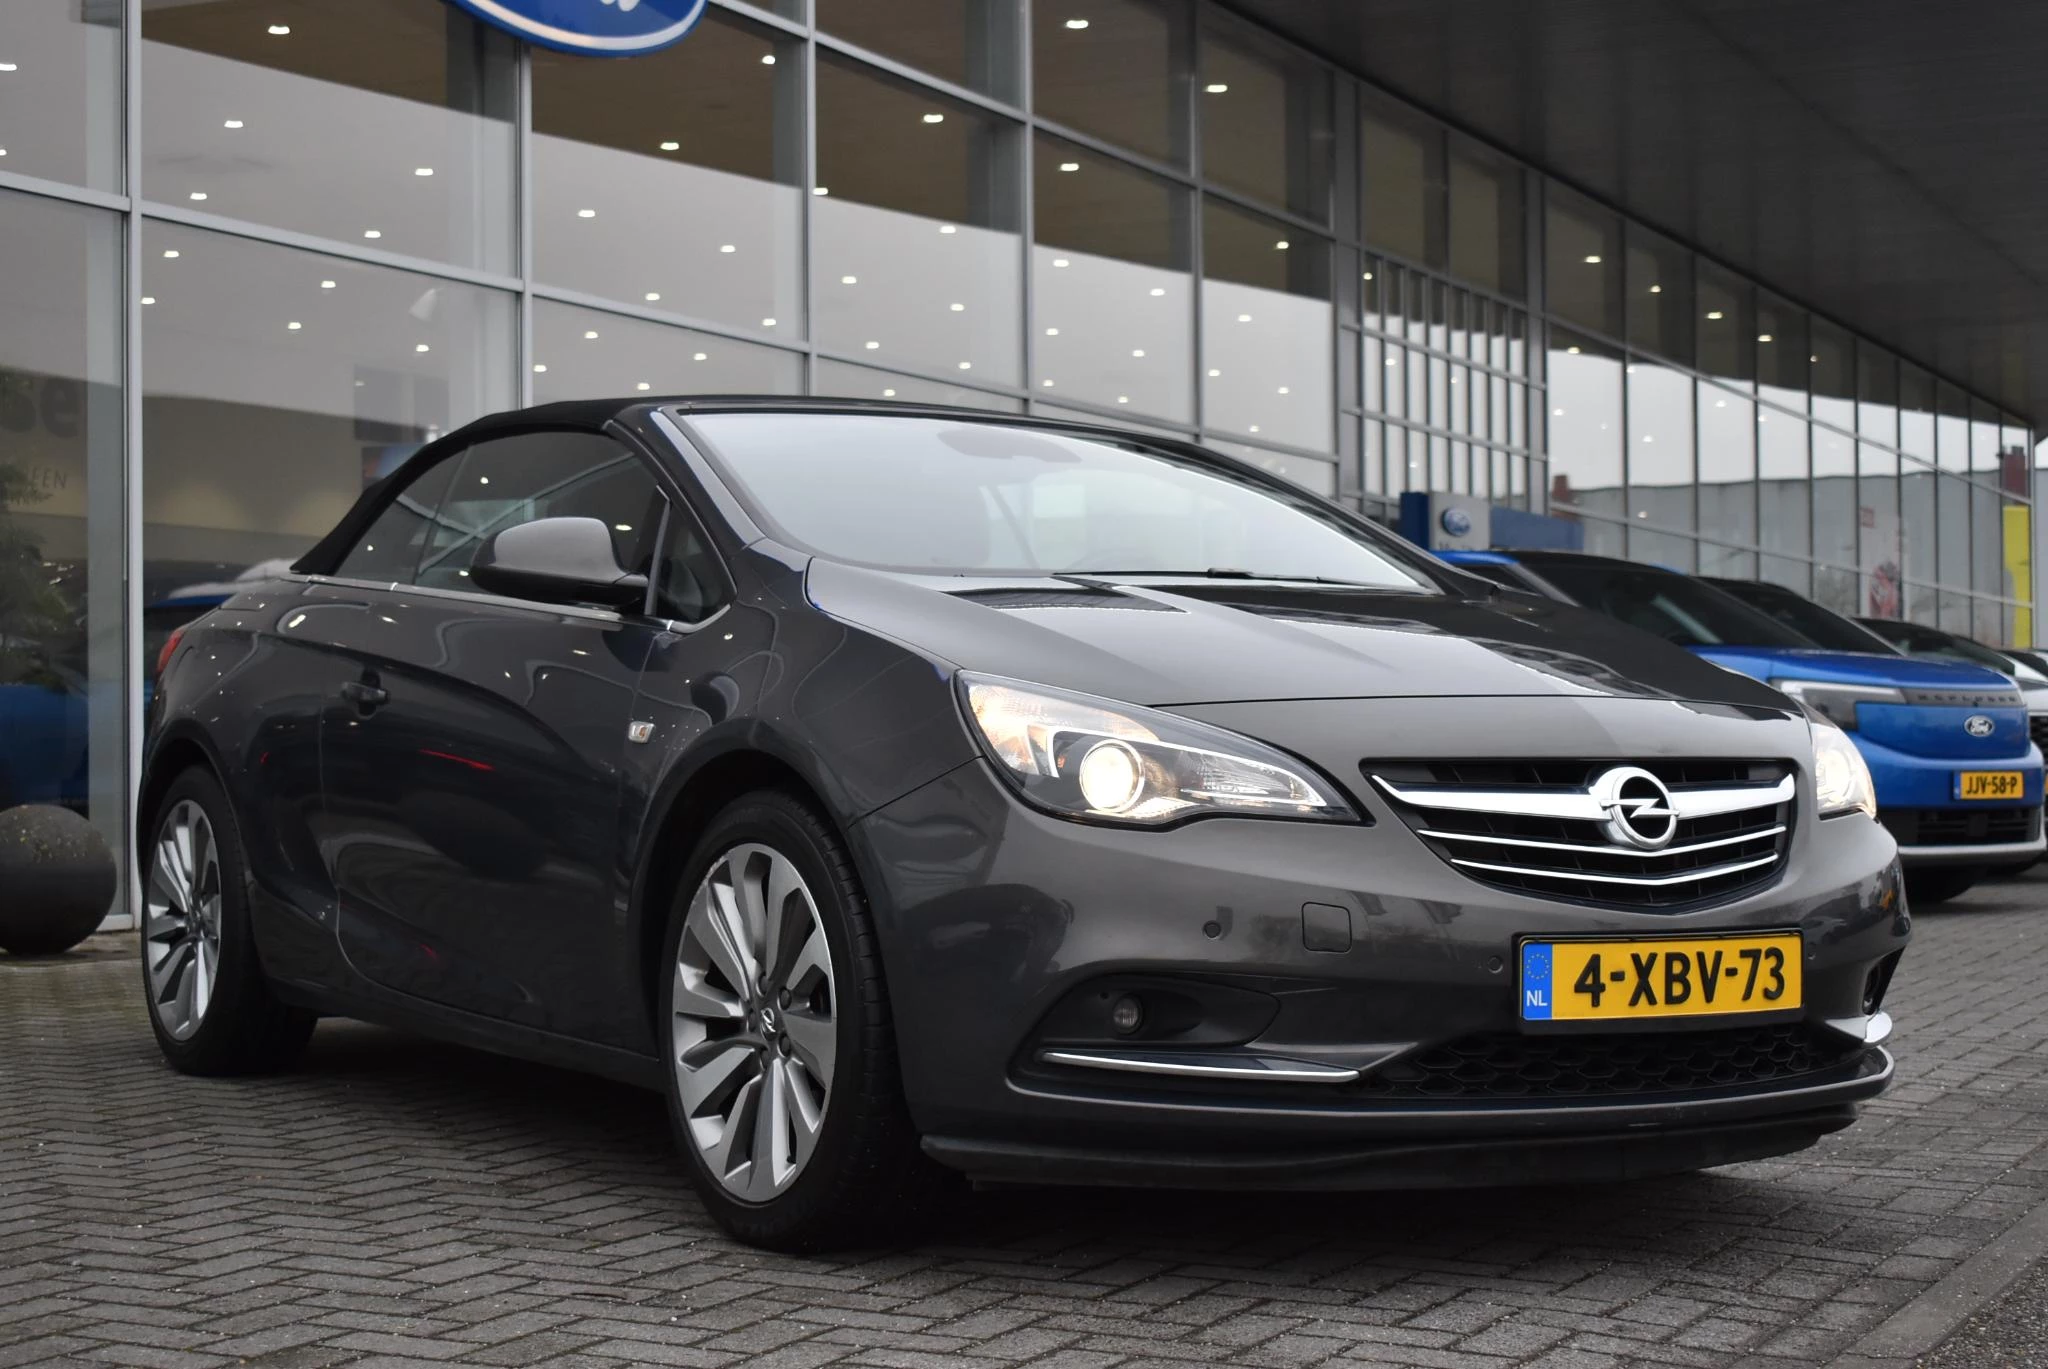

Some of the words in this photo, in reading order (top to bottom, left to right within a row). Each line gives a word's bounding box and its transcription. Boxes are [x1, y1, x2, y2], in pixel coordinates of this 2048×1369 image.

[1966, 775, 2018, 795] JJV-58-P
[1573, 946, 1786, 1008] 4-XBV-73
[1526, 989, 1548, 1007] NL
